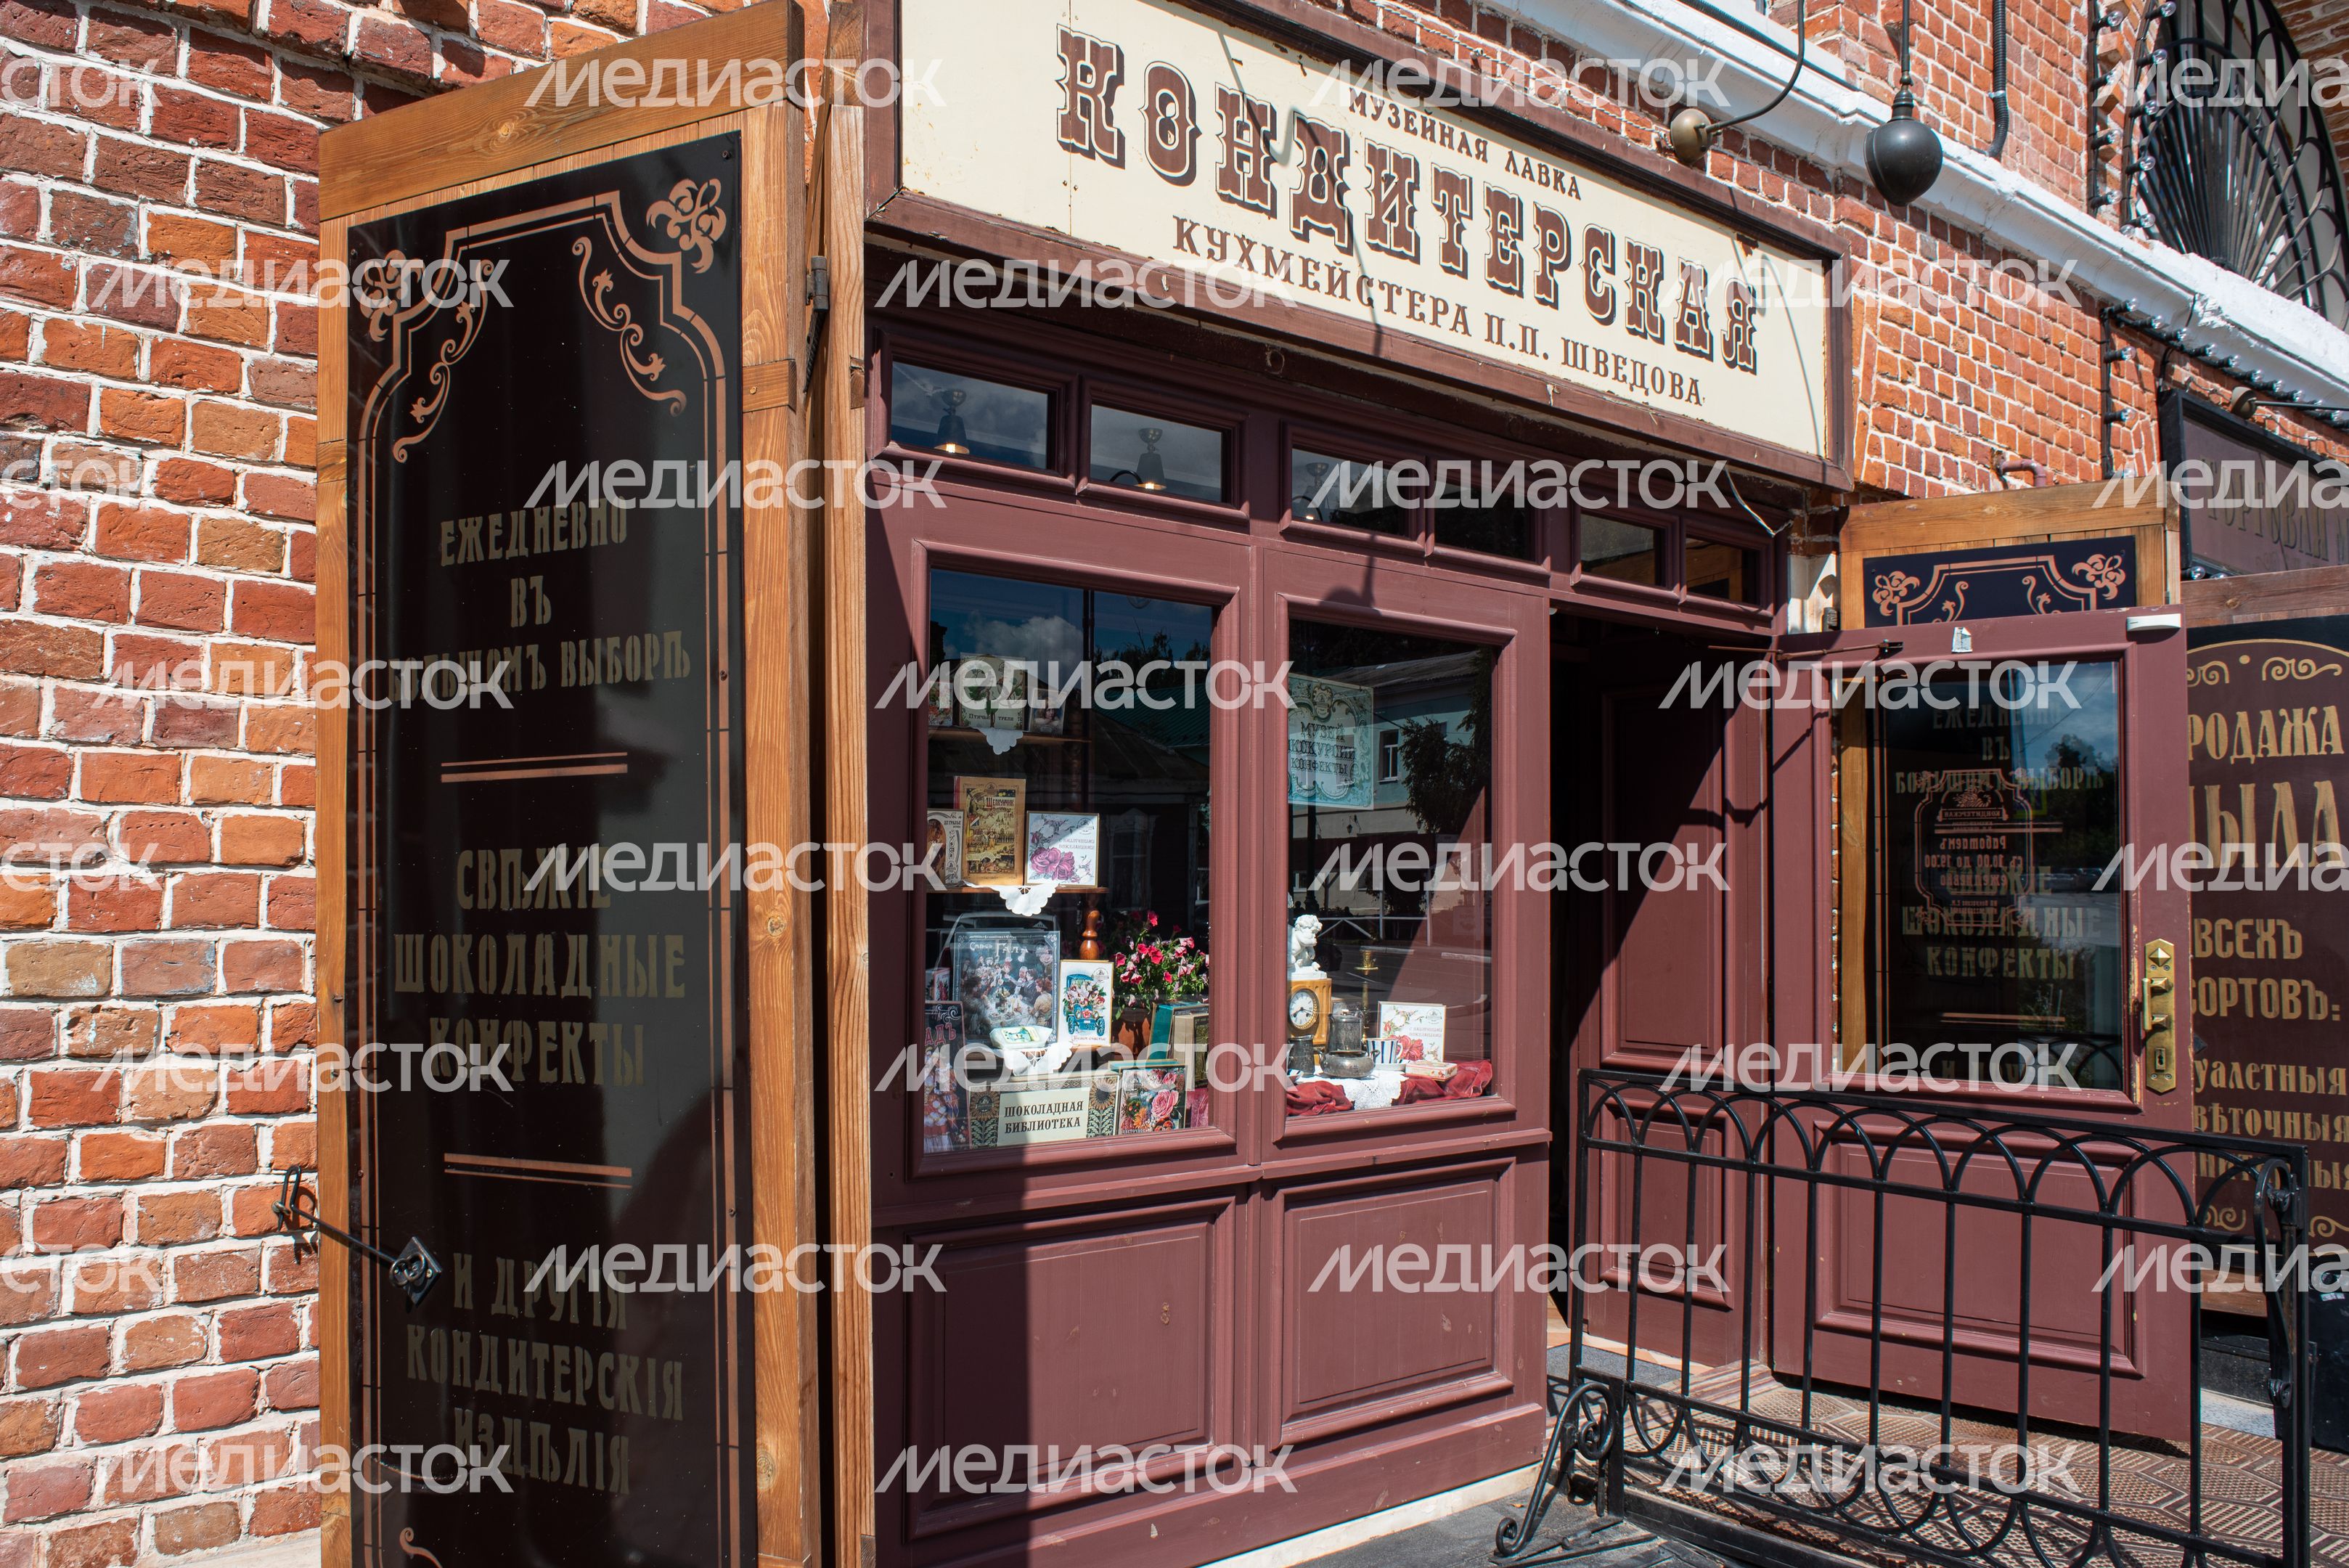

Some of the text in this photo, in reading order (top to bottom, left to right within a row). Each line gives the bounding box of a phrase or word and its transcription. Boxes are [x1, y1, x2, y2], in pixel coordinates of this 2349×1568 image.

[1349, 87, 1582, 200] МУЗЕЙНАЯ ЛАВКА
[1055, 23, 1757, 375] КОНДИТЕРСКАЯ
[1172, 215, 1704, 407] КУХМЕЙСТЕРА П.П. ШВЕДОВА
[440, 496, 627, 567] ЕЖЕДНЕВНО
[510, 575, 552, 628] ВЪ
[1291, 758, 1347, 774] КОНФЕКТЫ
[1982, 736, 2010, 761] ВЪ
[2189, 780, 2346, 869] ЫЛА
[393, 933, 685, 999] ШОКОЛАДНЫЕ
[1927, 945, 2075, 980] КОНФЕКТЫ
[2194, 918, 2303, 960] ВСЕХЪ
[430, 1016, 645, 1087] КОНФЕКТЫ
[1004, 1101, 1084, 1117] ШОКОЛАДНАЯ
[1005, 1116, 1081, 1133] БИБЛИОТЕКА
[453, 1252, 473, 1310] И
